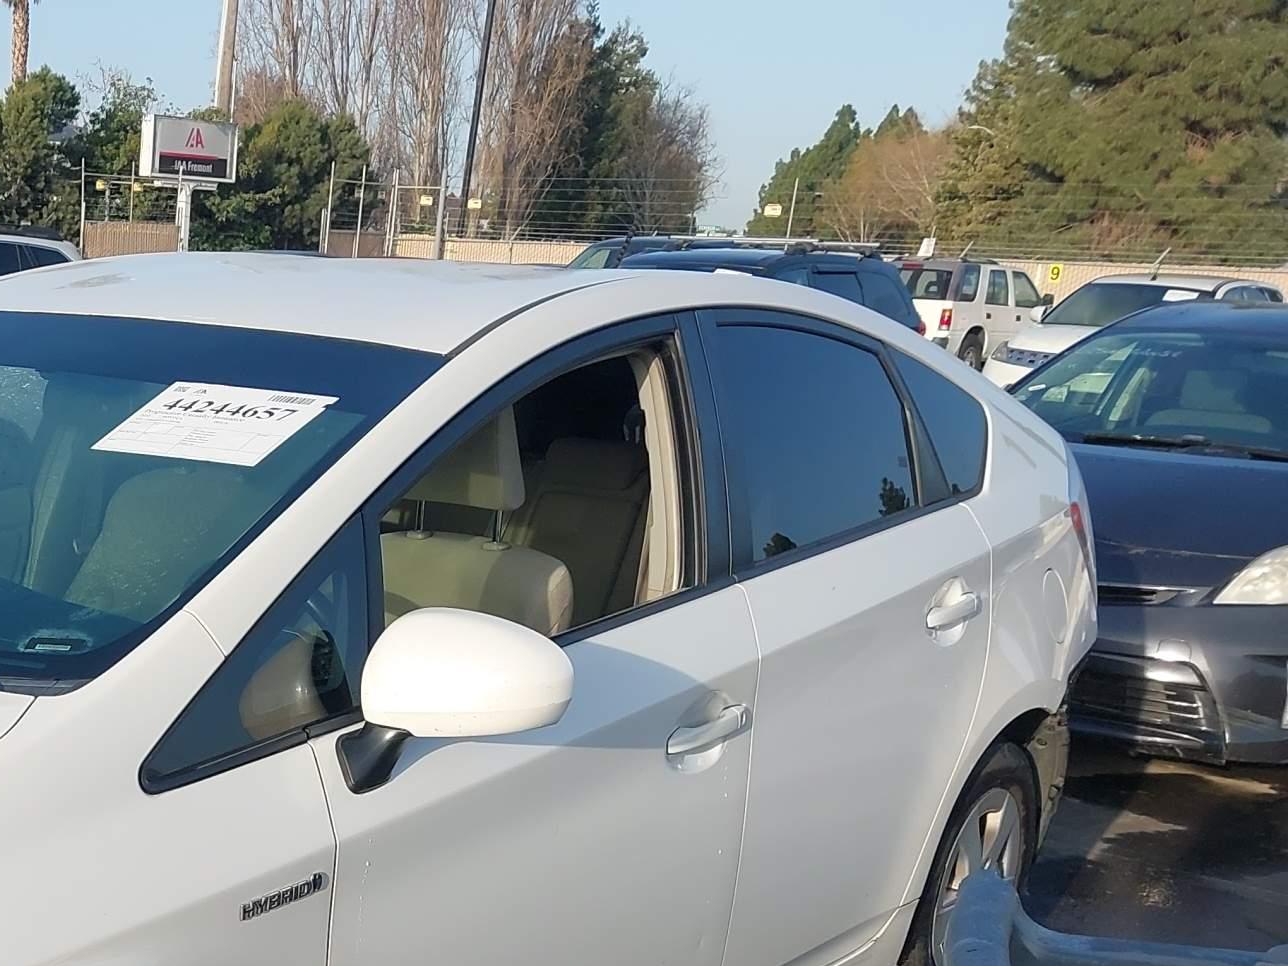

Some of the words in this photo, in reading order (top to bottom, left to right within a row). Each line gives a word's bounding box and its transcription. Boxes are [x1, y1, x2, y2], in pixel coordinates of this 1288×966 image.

[188, 161, 213, 173] Fremont
[1051, 266, 1060, 281] 9
[163, 398, 299, 421] 44244657
[240, 880, 312, 921] HYBRID
